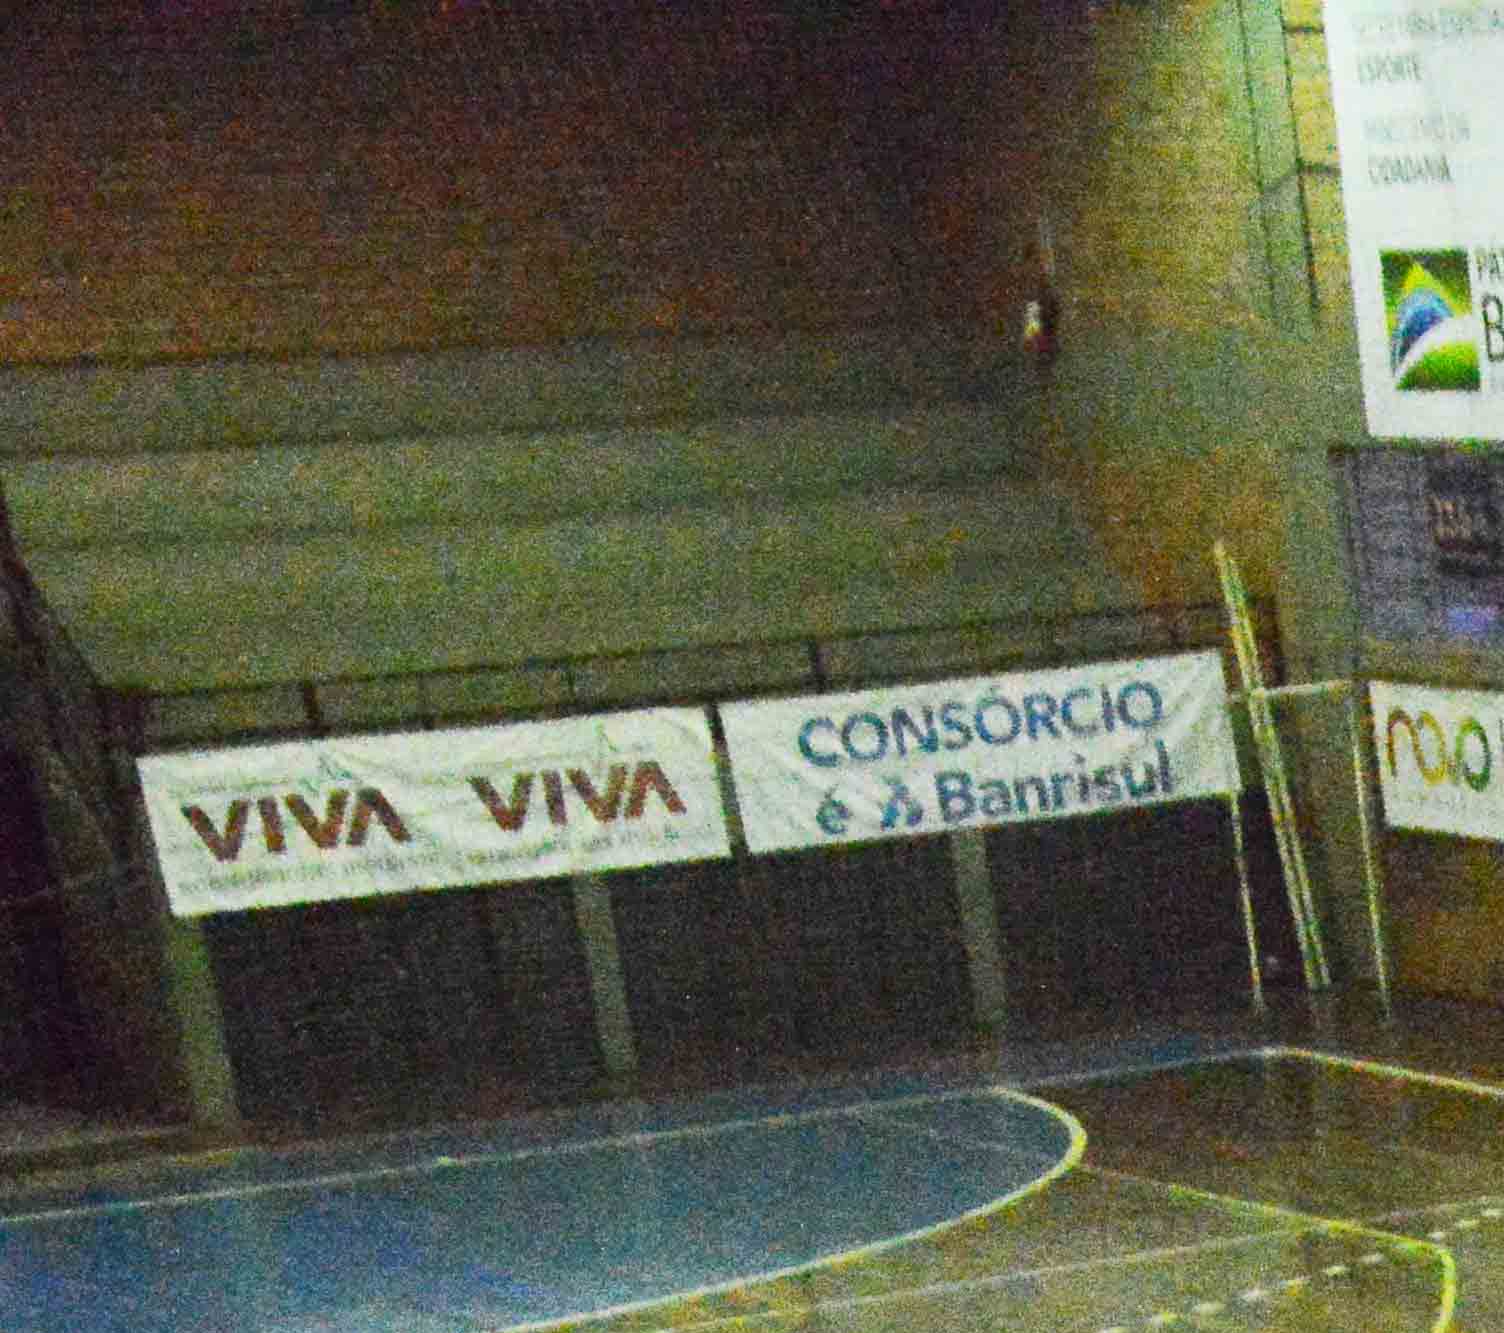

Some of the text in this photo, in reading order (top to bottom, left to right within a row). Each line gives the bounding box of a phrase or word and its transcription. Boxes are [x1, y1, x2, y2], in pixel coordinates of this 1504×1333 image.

[797, 680, 1164, 770] CONSÓRCIO
[181, 786, 412, 862] VIVA
[468, 760, 687, 832] VIVA
[936, 738, 1175, 828] Banrisul
